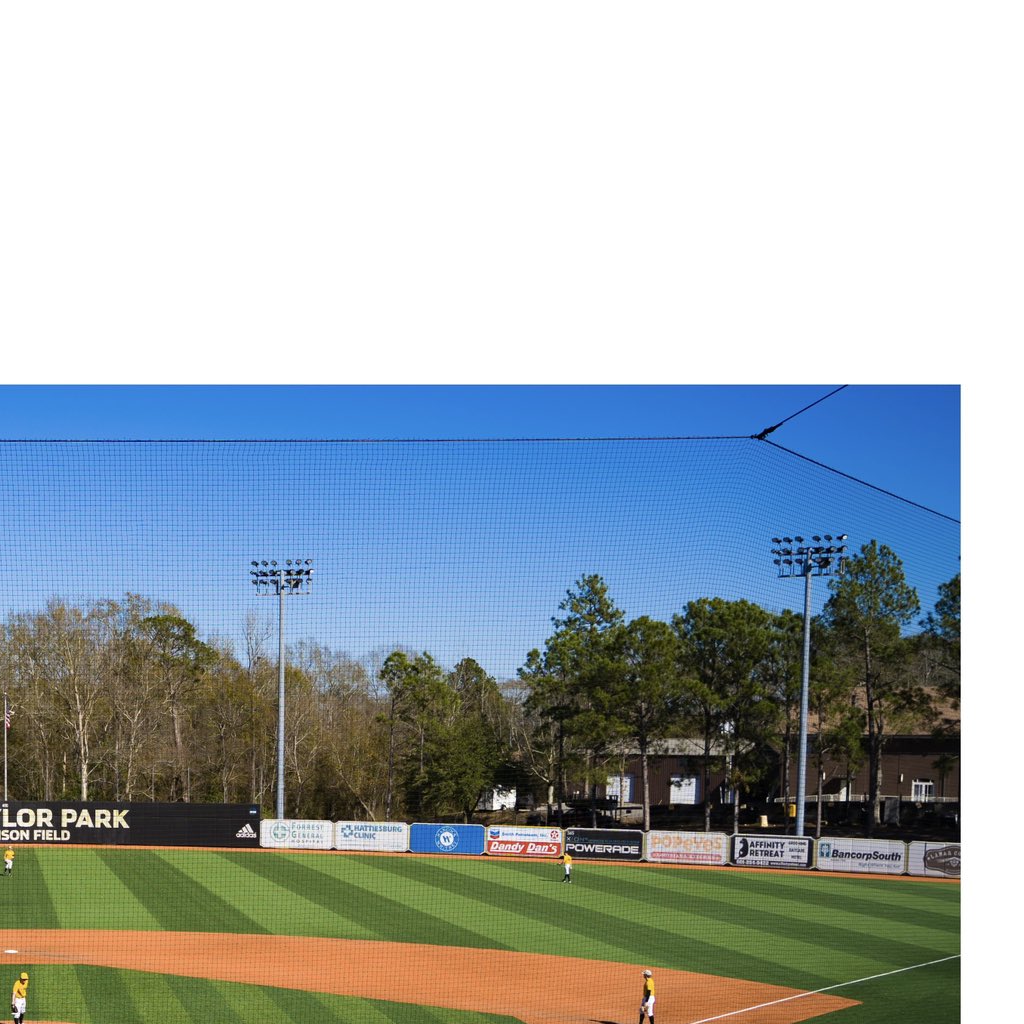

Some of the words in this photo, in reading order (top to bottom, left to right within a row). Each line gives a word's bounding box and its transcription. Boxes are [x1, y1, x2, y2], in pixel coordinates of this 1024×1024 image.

[61, 808, 130, 829] PARK
[291, 822, 324, 830] FORREST
[354, 824, 403, 833] HATTIESBURG
[33, 829, 71, 841] FIELD
[291, 830, 324, 839] GENERAL
[353, 832, 376, 840] CLINIC
[490, 841, 525, 853] Dandy
[526, 842, 558, 854] Dan's
[565, 843, 640, 855] POWERADE
[749, 841, 786, 849] AFFINITY
[749, 849, 785, 858] RETREAT
[831, 849, 902, 861] BancorpSouth
